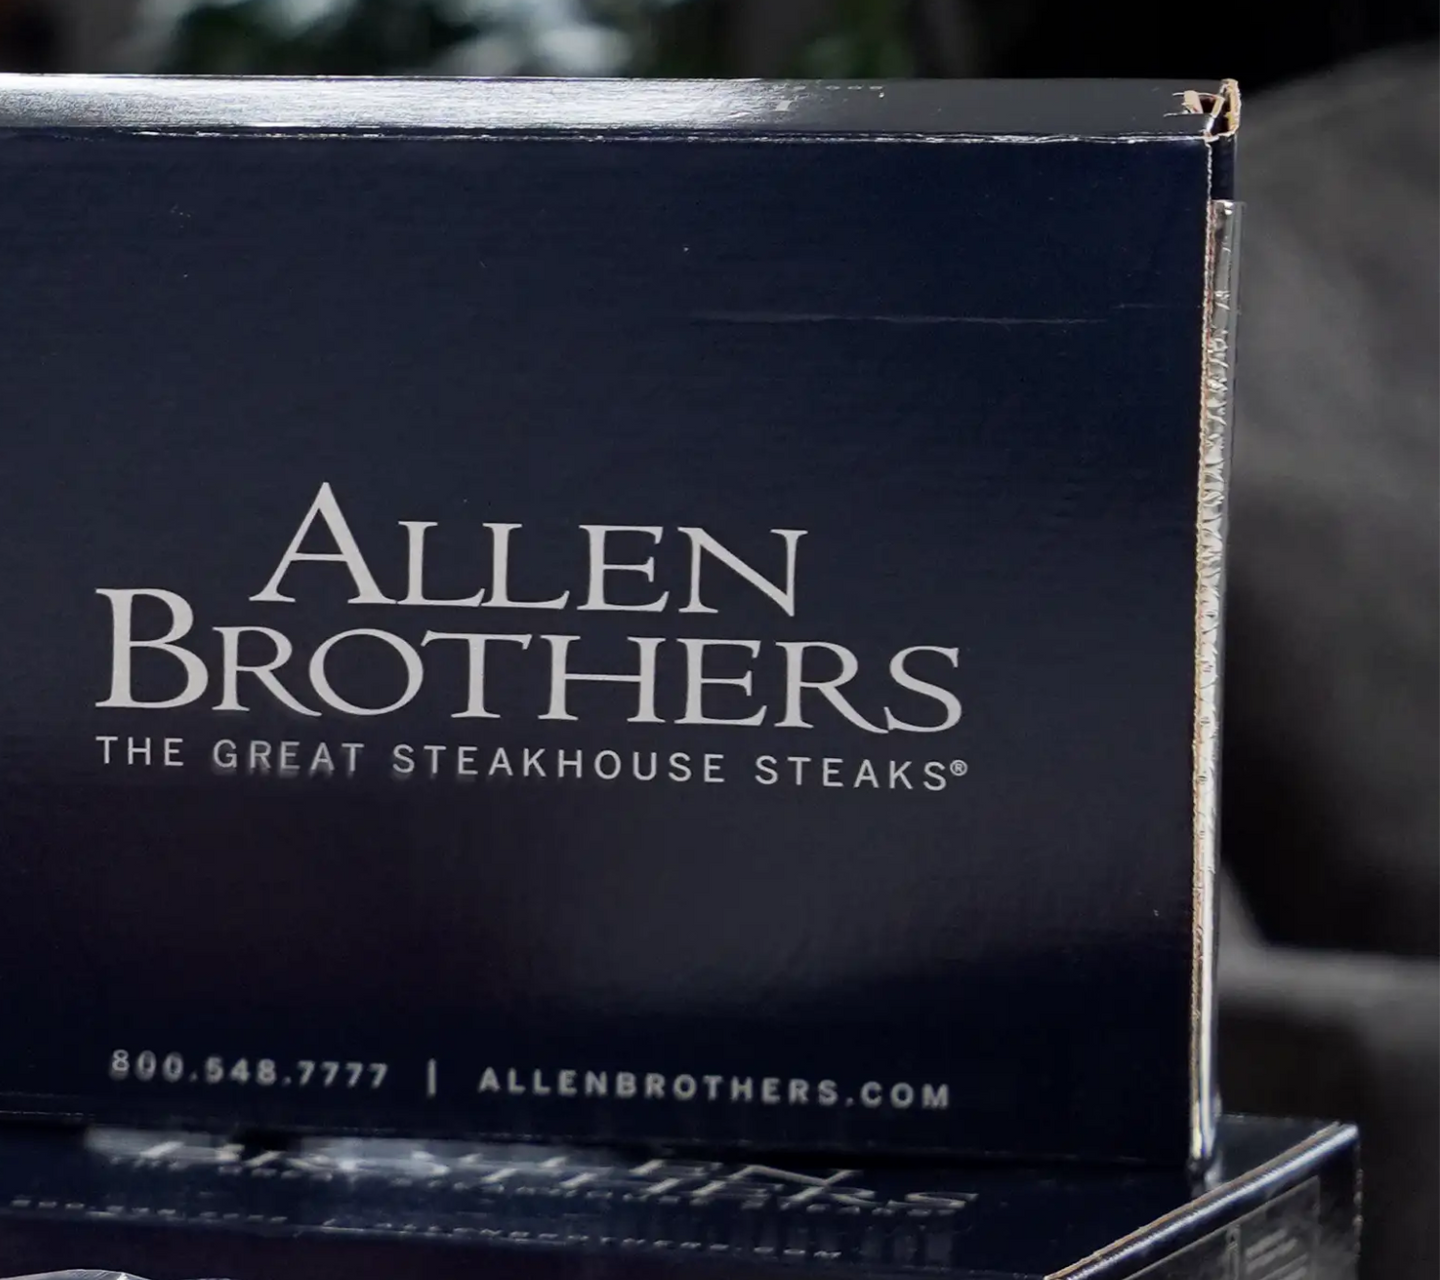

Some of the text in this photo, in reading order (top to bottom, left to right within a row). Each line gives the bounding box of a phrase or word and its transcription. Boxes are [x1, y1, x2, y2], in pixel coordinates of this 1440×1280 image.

[248, 480, 808, 618] ALLEN
[94, 587, 964, 734] BROTHERS
[95, 736, 184, 768] THE
[212, 738, 364, 774] GREAT
[393, 742, 726, 784] STEAKHOUSE
[110, 1049, 949, 1110] 800.548.7777 ALLENBROTHERS.COM
